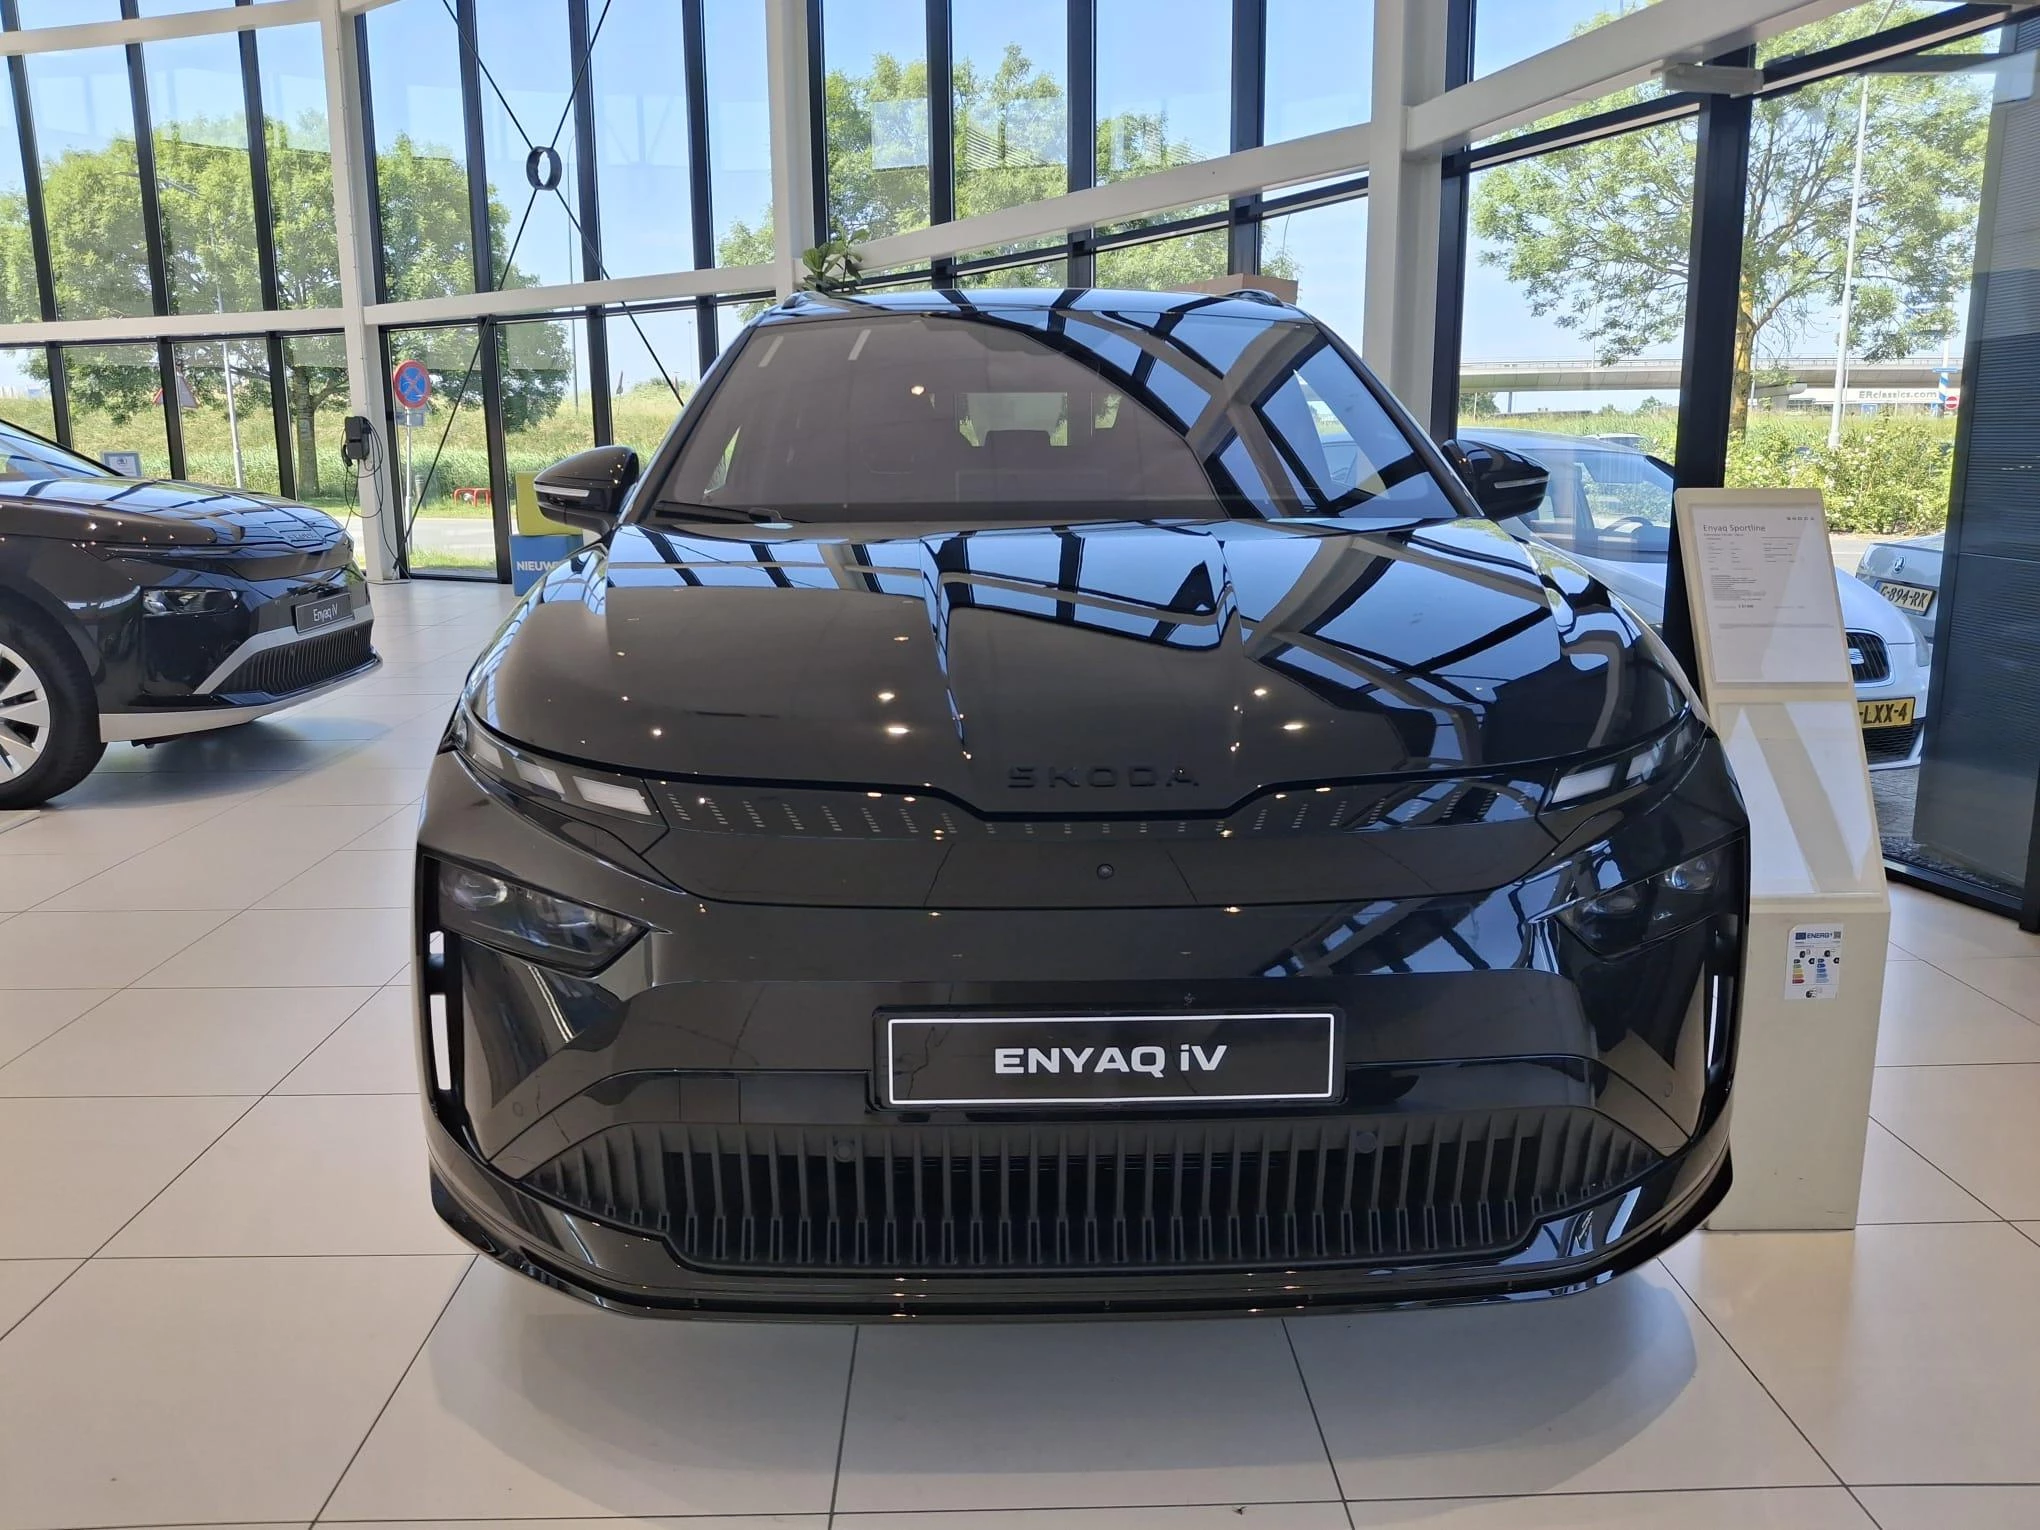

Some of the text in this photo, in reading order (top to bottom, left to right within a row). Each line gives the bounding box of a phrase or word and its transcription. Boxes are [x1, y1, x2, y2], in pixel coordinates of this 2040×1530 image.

[1858, 390, 1937, 399] ERclassics.com
[1703, 524, 1766, 532] Enyaq Sportline
[313, 607, 332, 622] Enyaq
[993, 1045, 1228, 1077] ENYAQ iV
